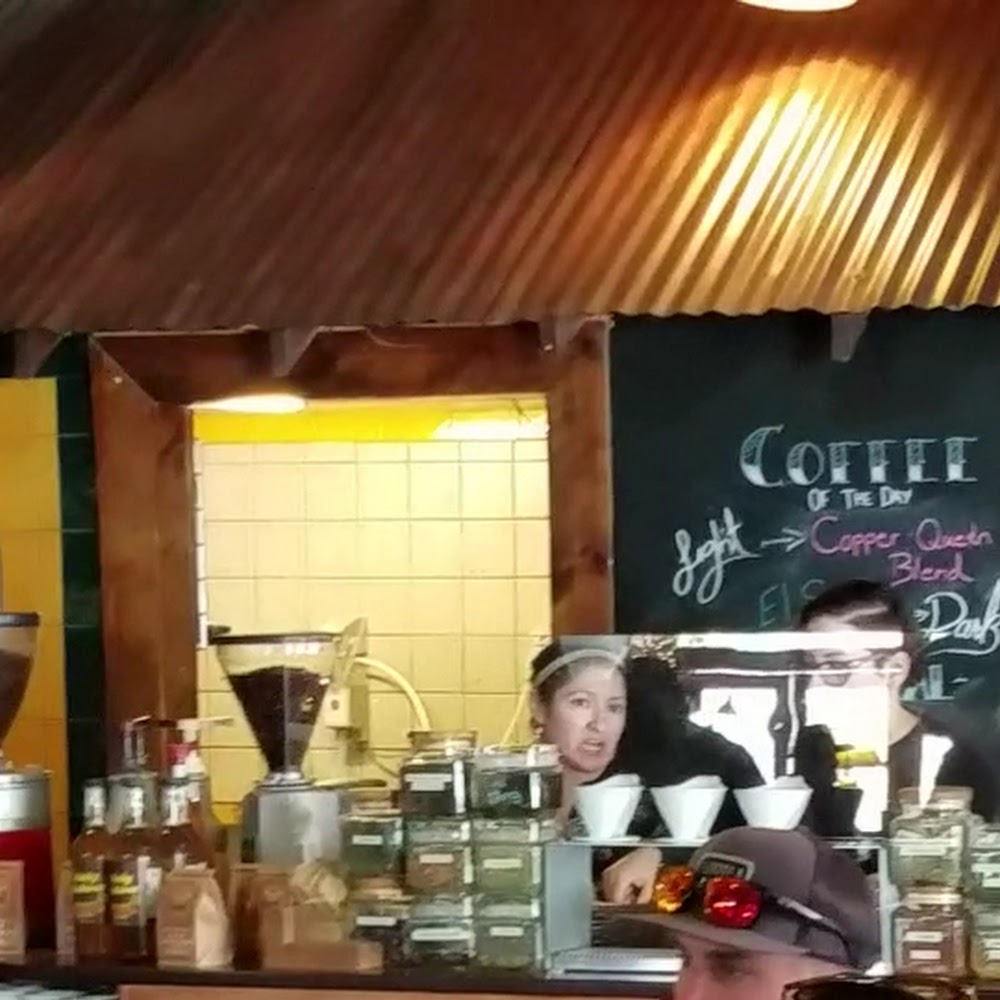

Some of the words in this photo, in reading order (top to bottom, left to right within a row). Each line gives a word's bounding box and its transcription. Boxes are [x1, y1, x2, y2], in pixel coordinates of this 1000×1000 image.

[739, 424, 978, 487] COFFEE
[807, 488, 830, 512] OF
[880, 487, 913, 509] DAY
[672, 506, 760, 606] Light
[810, 515, 901, 557] Copper
[888, 552, 976, 588] Blend
